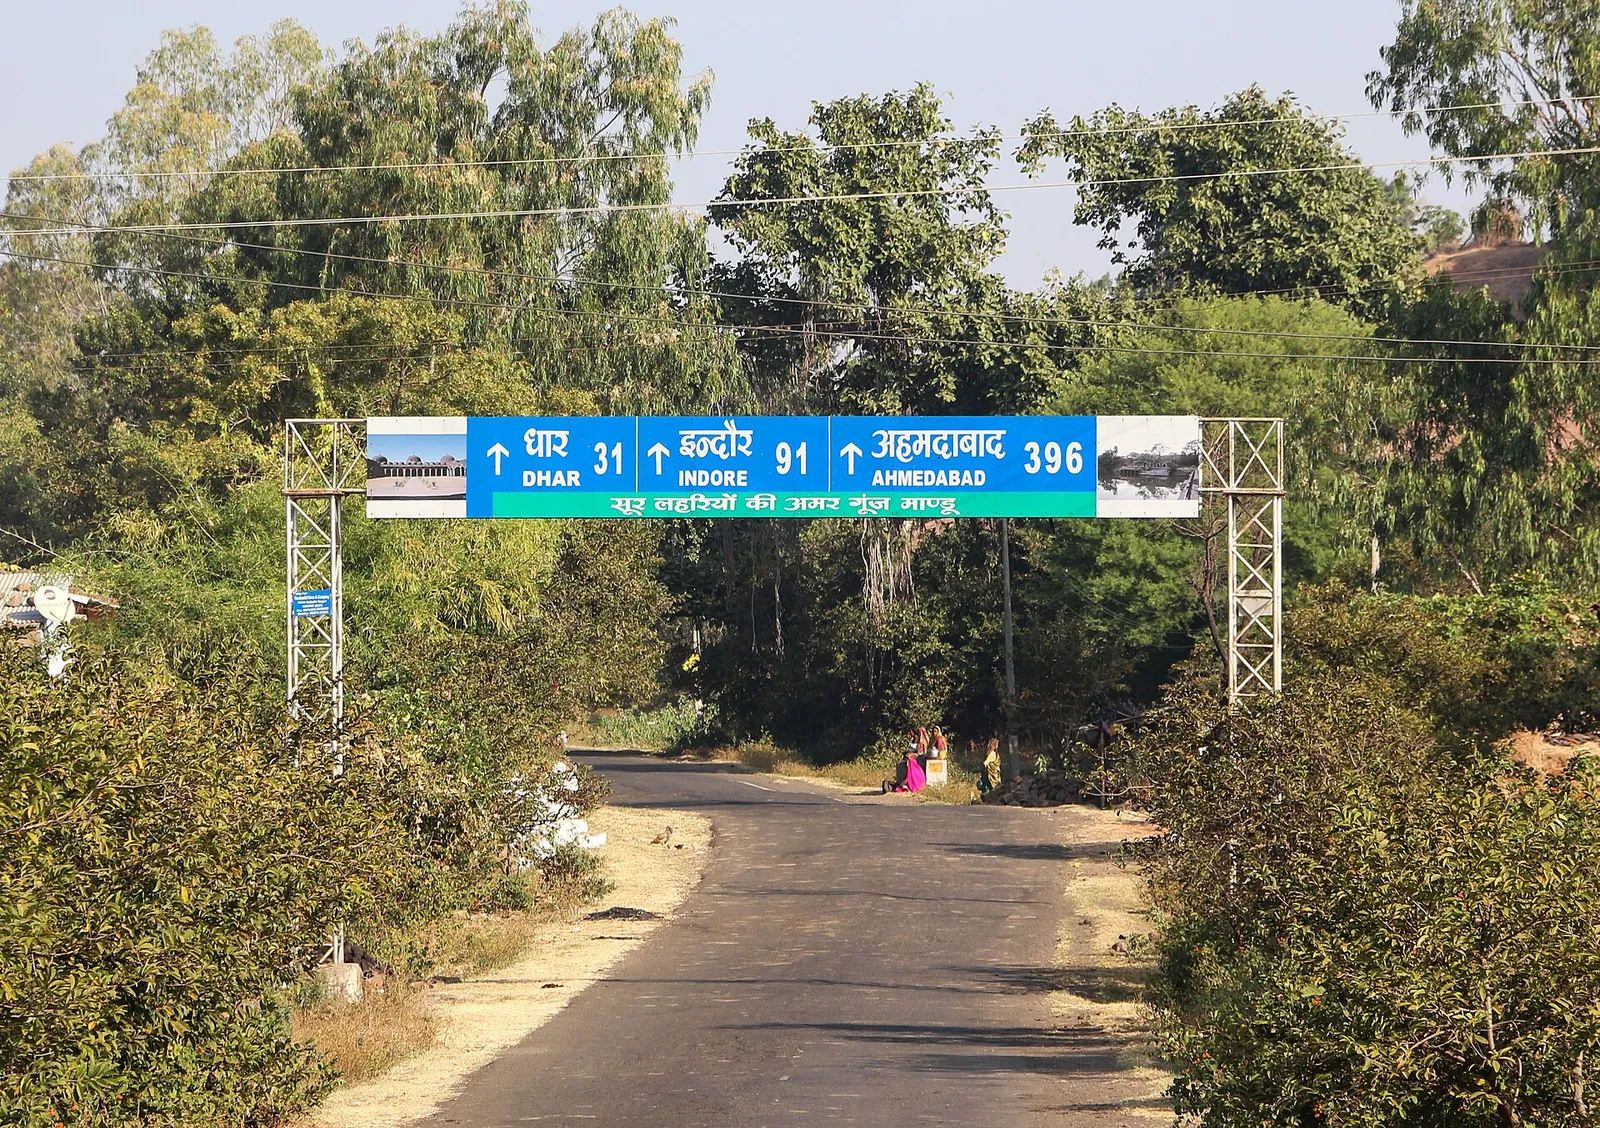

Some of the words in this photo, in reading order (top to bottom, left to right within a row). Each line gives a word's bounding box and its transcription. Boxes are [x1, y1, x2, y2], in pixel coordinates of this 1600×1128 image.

[523, 427, 570, 458] धार
[678, 419, 754, 460] इन्दौर
[871, 429, 1007, 463] अहमदाबाद
[593, 441, 622, 475] 31
[775, 441, 807, 475] 91
[1023, 441, 1083, 474] 396
[522, 470, 581, 487] DHAR
[678, 469, 748, 487] INDORE
[871, 469, 986, 487] AHMEDABAD
[610, 497, 647, 516] सूर
[653, 492, 738, 513] लहरियों
[745, 493, 777, 511] की
[784, 497, 841, 511] अमर
[848, 493, 891, 515] गूंज
[900, 497, 961, 516] माण्डू
